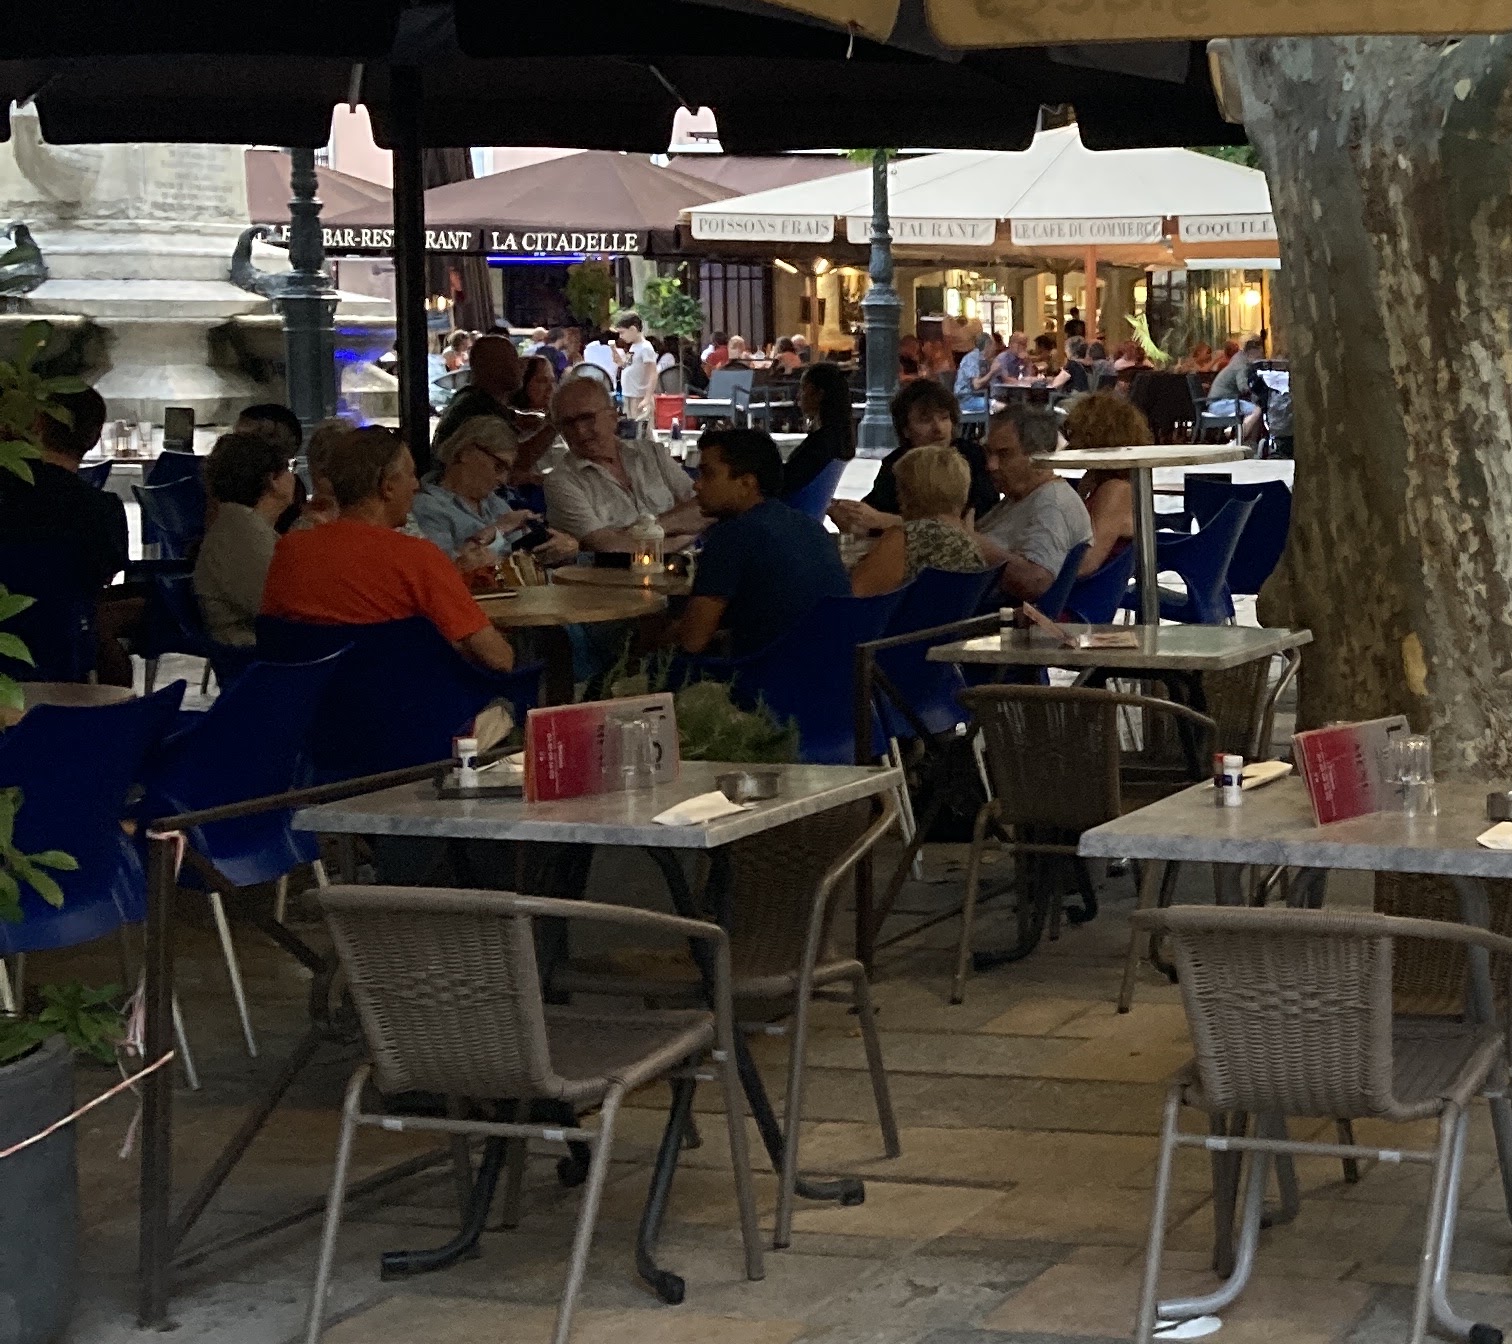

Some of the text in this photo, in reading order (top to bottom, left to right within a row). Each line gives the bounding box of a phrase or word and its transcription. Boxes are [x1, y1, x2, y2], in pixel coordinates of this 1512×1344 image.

[698, 218, 830, 236] POISSONS FRAIS
[863, 222, 979, 238] RSTAURANT
[1014, 223, 1031, 239] LE
[1069, 222, 1085, 238] DU
[1089, 221, 1161, 238] COMMERCE
[491, 231, 639, 252] LA CITADELLE
